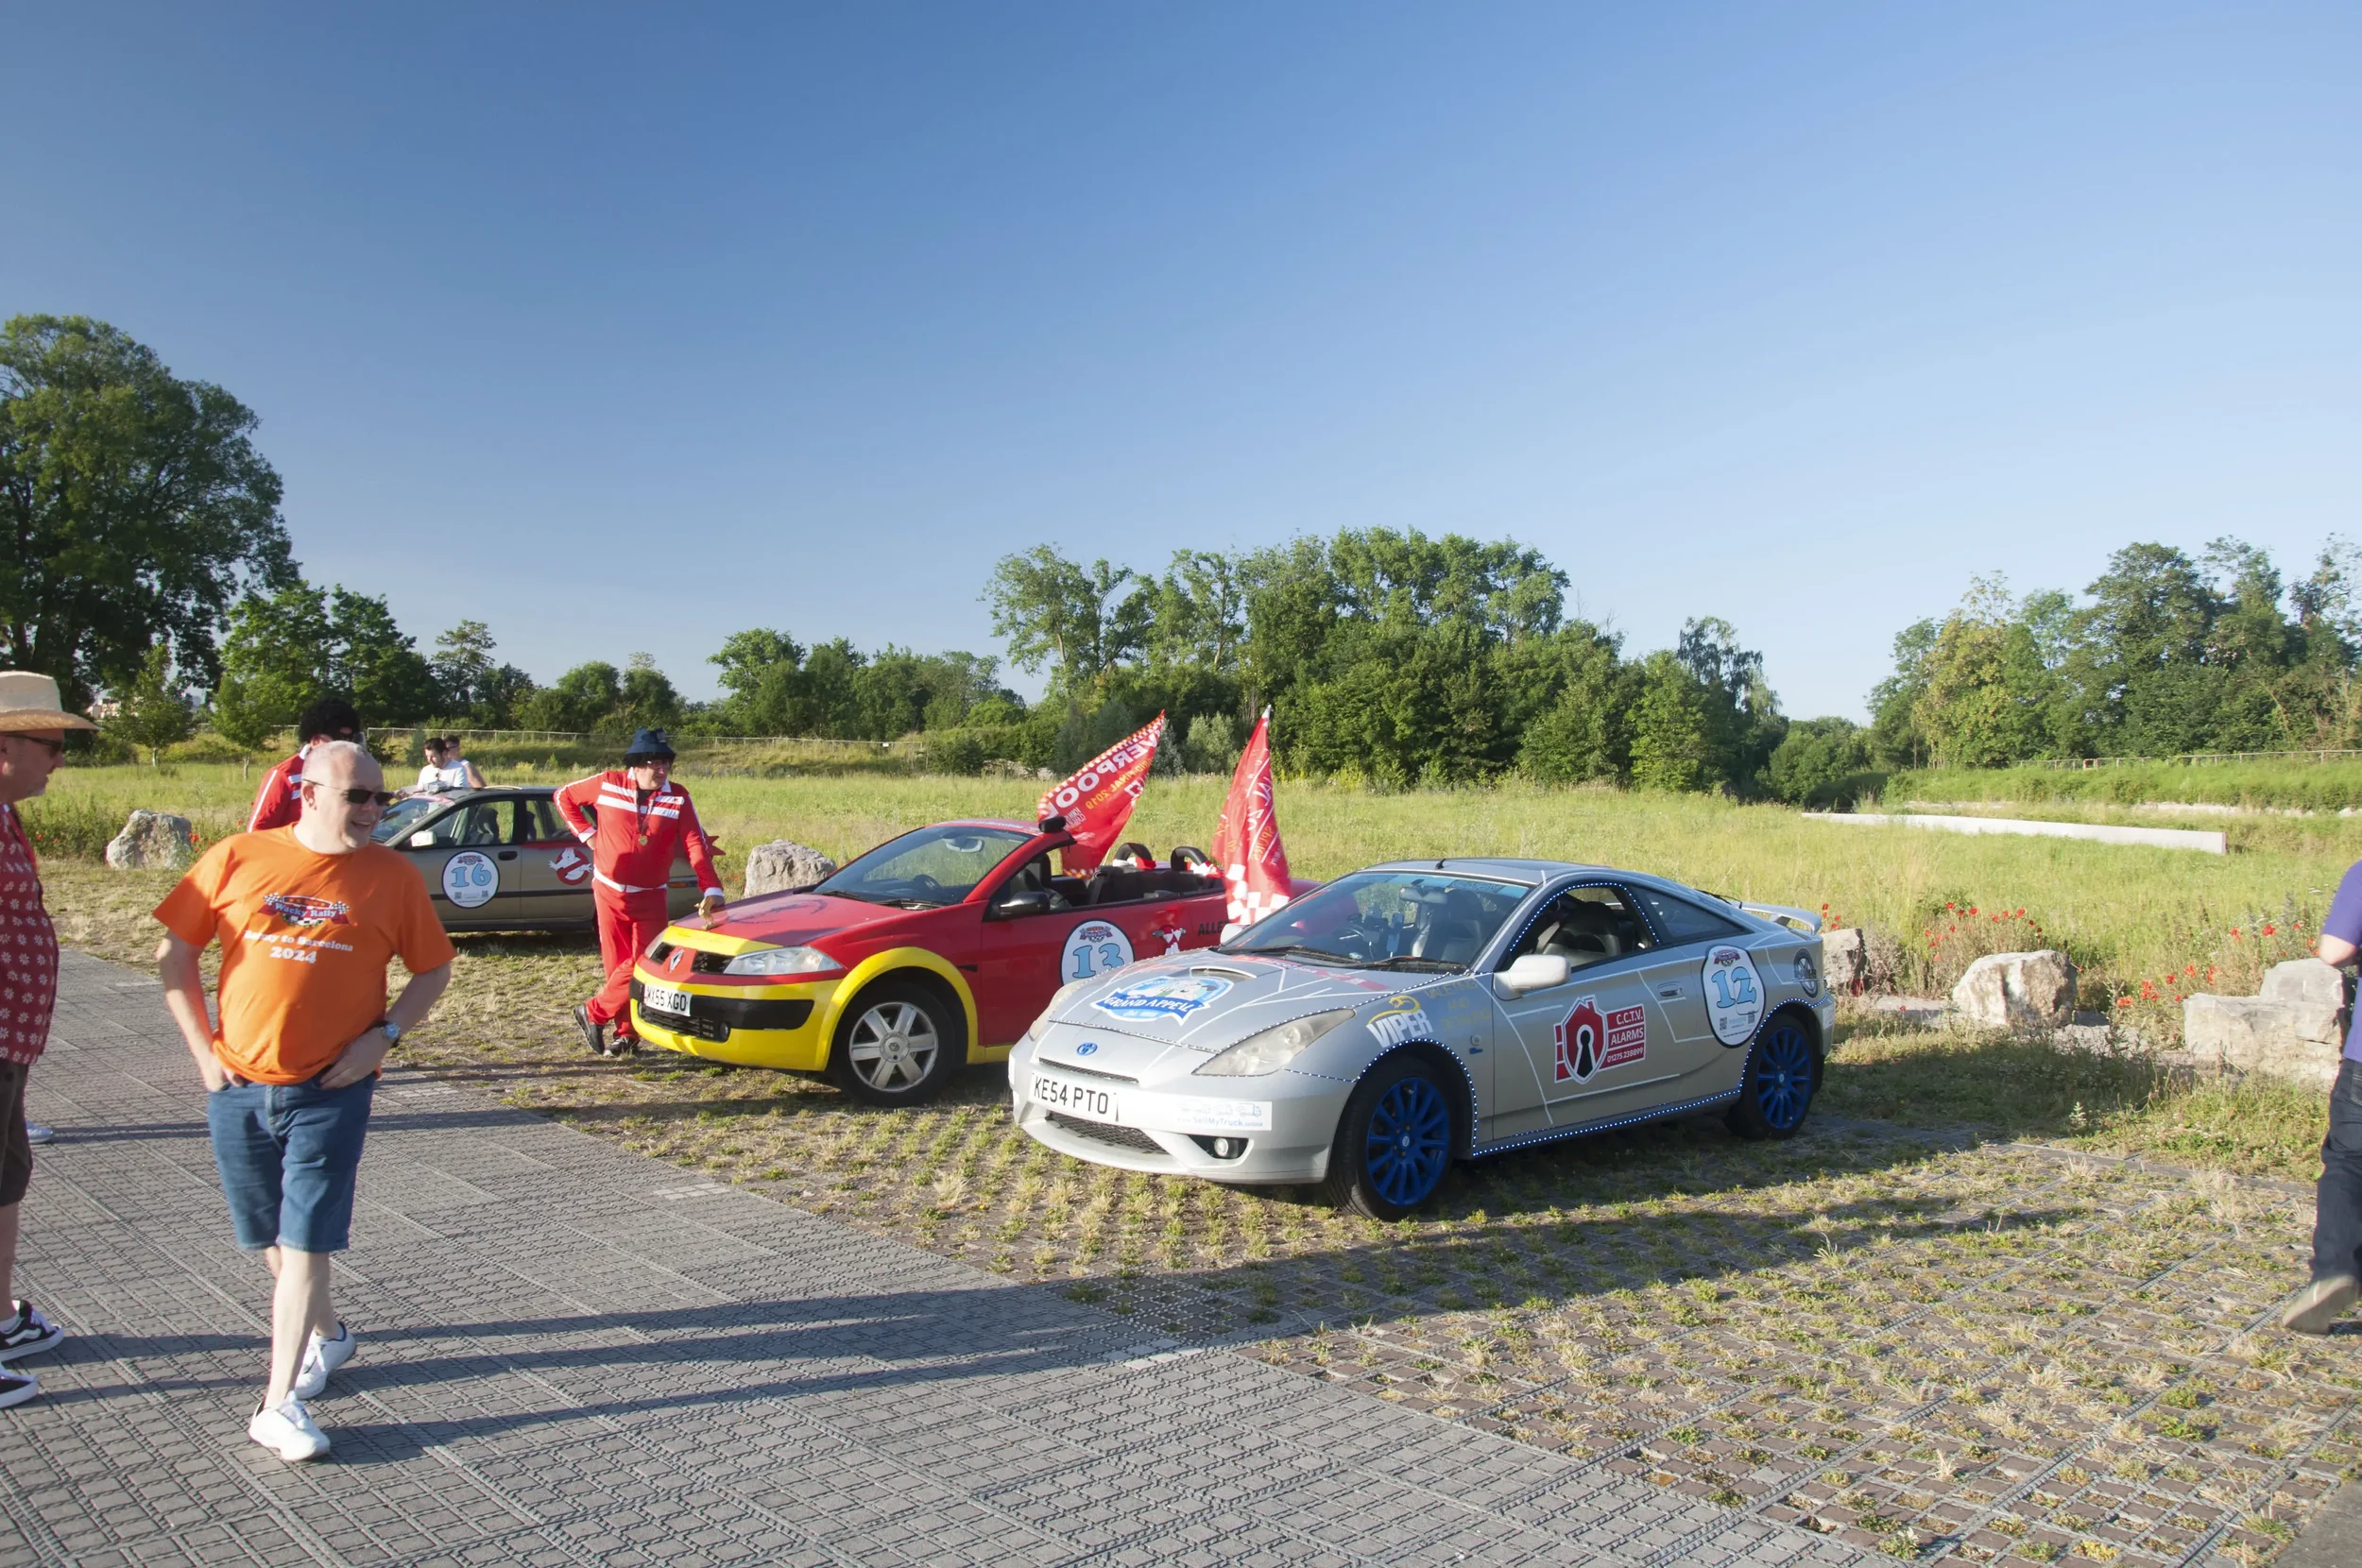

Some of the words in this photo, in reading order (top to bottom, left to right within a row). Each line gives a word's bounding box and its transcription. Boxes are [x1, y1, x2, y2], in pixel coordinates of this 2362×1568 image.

[451, 863, 492, 888] 16
[275, 902, 308, 917] Wacky
[310, 909, 337, 918] Rally
[1198, 920, 1228, 937] ALLE
[297, 936, 353, 952] Barcelona
[269, 946, 317, 963] 2024
[1072, 943, 1125, 979] 13
[1711, 966, 1757, 1008] 12
[667, 991, 687, 1012] XGO
[1104, 997, 1143, 1008] GRAND
[1616, 1009, 1644, 1026] C.C.T.V.
[1366, 1009, 1434, 1048] VIPER
[1610, 1027, 1644, 1046] ALARMS
[1033, 1076, 1068, 1106] KE54
[1072, 1086, 1109, 1116] PTO
